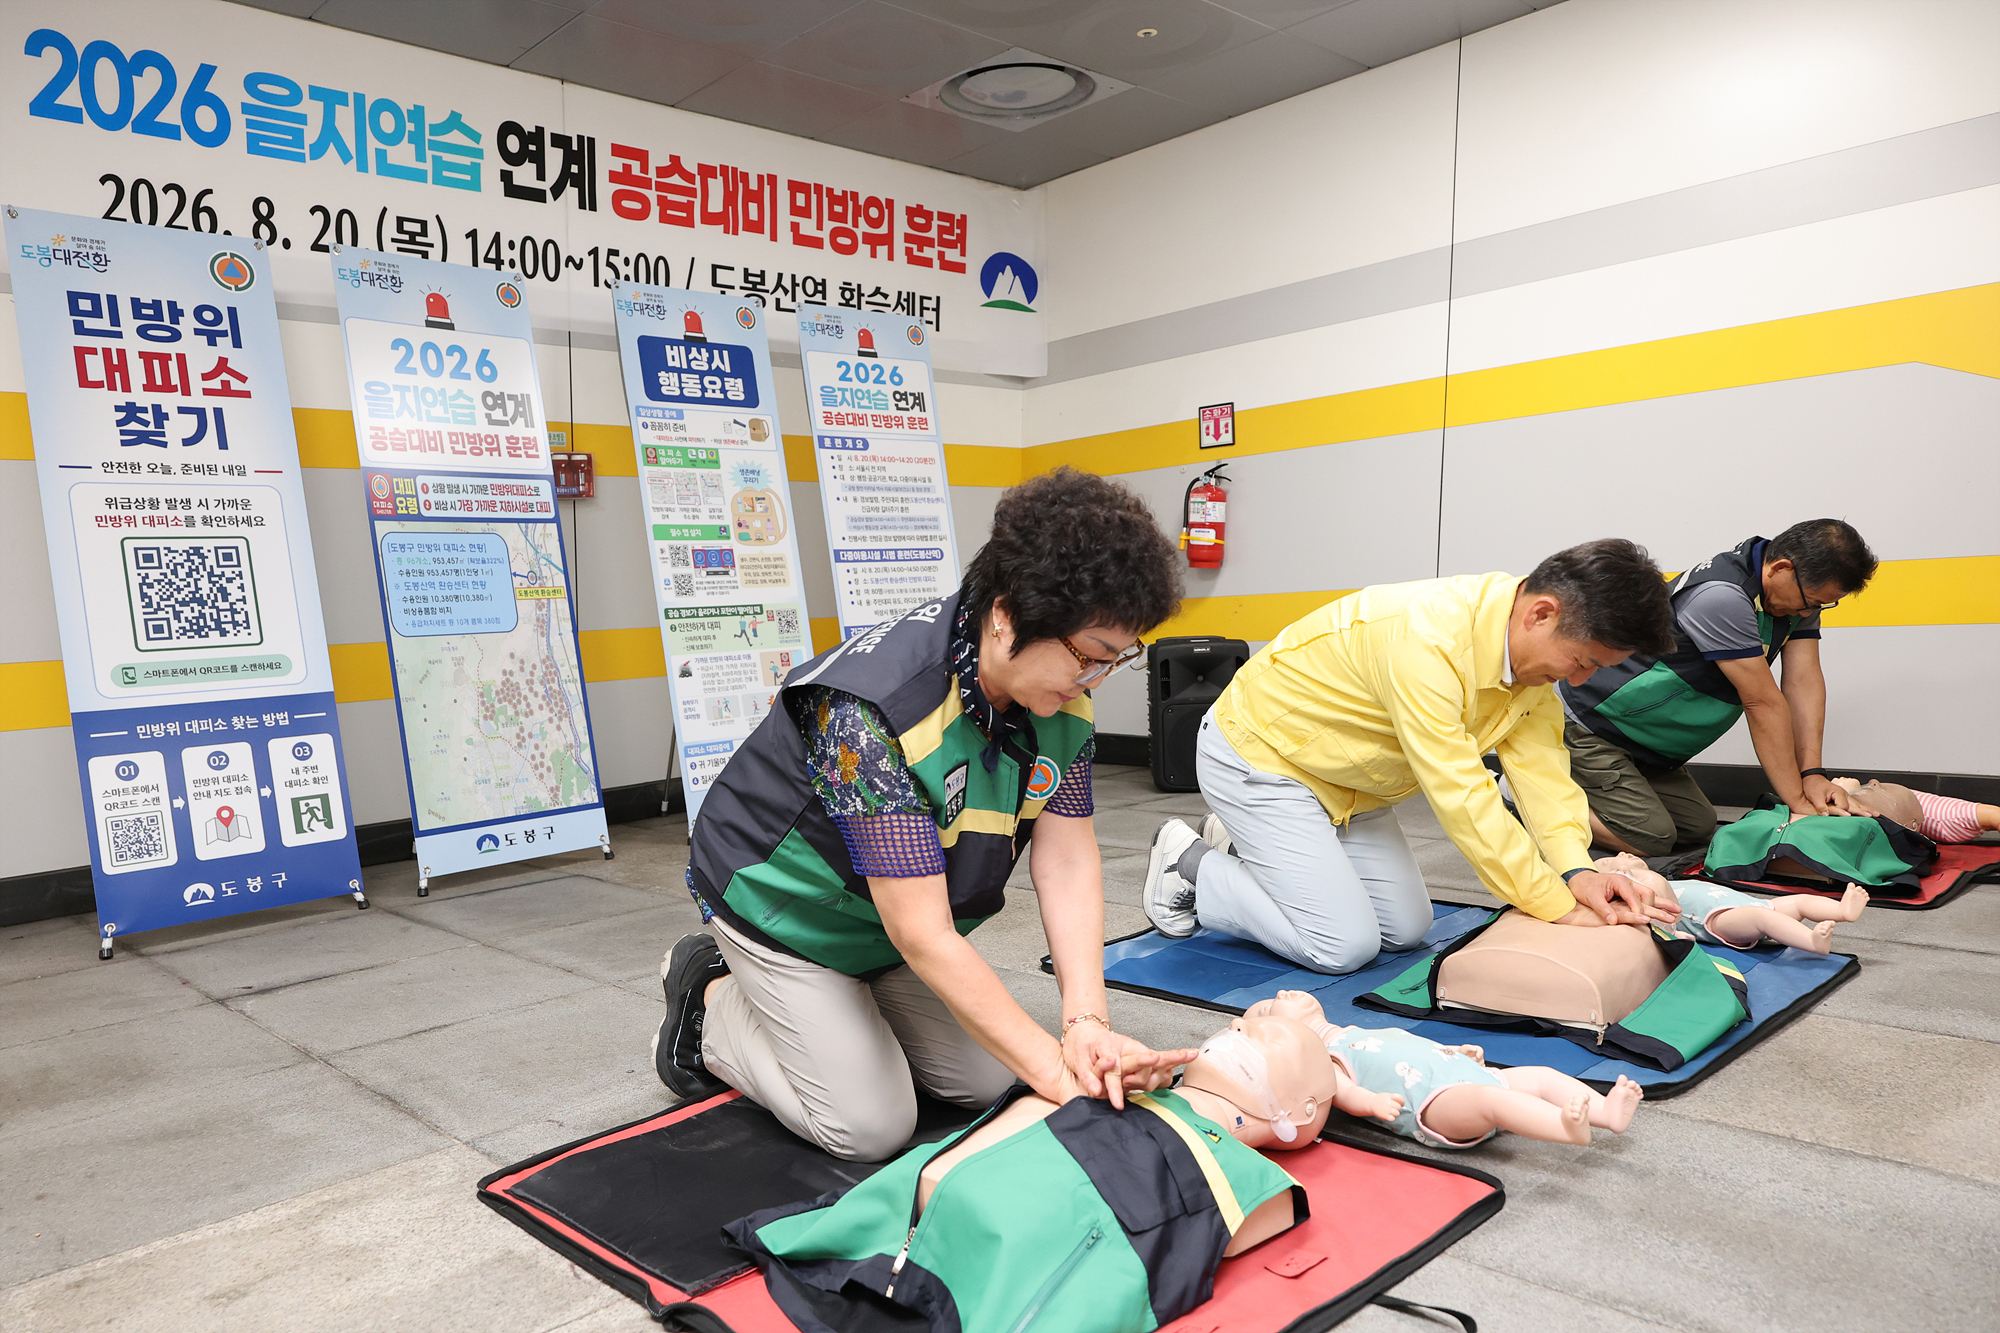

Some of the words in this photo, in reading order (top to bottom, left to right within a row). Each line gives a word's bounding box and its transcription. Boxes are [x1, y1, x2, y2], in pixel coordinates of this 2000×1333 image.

[24, 28, 231, 148] 2026
[241, 71, 484, 192] 을지연습
[496, 120, 597, 213] 연계
[608, 142, 777, 242] 공습대비
[787, 179, 894, 261] 민방위
[904, 203, 967, 274] 훈련
[99, 174, 232, 236] 2026.
[252, 197, 291, 250] 8.
[309, 205, 369, 253] 20
[376, 206, 447, 262] (목)
[465, 228, 670, 289] 14:00~15:00
[66, 290, 242, 349] 민방위
[391, 338, 498, 383] 2026
[665, 345, 731, 373] 비상시
[73, 345, 252, 399] 대피소
[836, 361, 903, 386] 2026
[657, 370, 745, 401] 행동요령
[364, 381, 477, 425] 을지연습
[481, 390, 535, 428] 연계
[820, 386, 889, 411] 을지연습
[893, 390, 926, 413] 연계
[822, 411, 868, 427] 공습대비
[871, 414, 904, 429] 민방위
[907, 416, 929, 430] 훈련
[1204, 407, 1230, 418] 소화기
[114, 401, 229, 450] 찾기
[650, 421, 671, 432] 꼼꼼히
[672, 423, 686, 432] 준비
[369, 426, 444, 454] 공습대비
[448, 432, 501, 457] 민방위
[505, 435, 540, 459] 훈련
[101, 461, 142, 475] 안전한
[147, 463, 176, 475] 오늘,
[180, 464, 218, 476] 준비된
[222, 464, 247, 476] 내일
[393, 477, 416, 495] 대피
[432, 483, 445, 494] 상황
[447, 483, 460, 494] 발생
[462, 484, 468, 495] 시
[470, 484, 488, 495] 가까운
[490, 483, 540, 497] 민방위대피소로
[105, 497, 160, 510] 위급상황
[165, 498, 191, 511] 발생
[197, 498, 209, 511] 시
[214, 499, 252, 510] 가까운
[373, 501, 393, 509] 대피소
[396, 497, 419, 514] 요령
[435, 500, 448, 511] 비상
[450, 501, 457, 511] 시
[457, 499, 473, 512] 가장
[475, 500, 498, 512] 가까운
[500, 501, 534, 513] 지하시설로
[536, 501, 551, 513] 대피
[95, 515, 137, 528] 민방위
[142, 515, 196, 528] 대피소를
[201, 515, 266, 528] 확인하세요
[417, 543, 440, 553] 민방위
[443, 543, 466, 553] 대피소
[668, 609, 679, 618] 공습
[680, 609, 697, 617] 경보가
[678, 622, 706, 632] 안전하게
[707, 621, 721, 630] 대피
[143, 668, 197, 679] 스마트폰에서
[199, 665, 238, 676] QR코드를
[240, 661, 282, 672] 스캔하세요
[136, 721, 181, 739] 민방위
[185, 718, 228, 735] 대피소
[232, 714, 259, 730] 찾는
[262, 712, 290, 726] 방법
[294, 746, 310, 758] 03
[210, 755, 227, 767] 02
[118, 764, 135, 777] 01
[291, 766, 300, 776] 내
[302, 764, 319, 775] 주변
[192, 776, 220, 788] 민방위
[222, 773, 249, 785] 대피소
[284, 777, 310, 789] 대피소
[312, 775, 329, 786] 확인
[102, 783, 160, 799] 스마트폰에서
[192, 789, 212, 801] 안내
[214, 787, 232, 799] 지도
[234, 785, 252, 797] 접속
[104, 799, 138, 812] QR코드
[142, 796, 161, 808] 스캔
